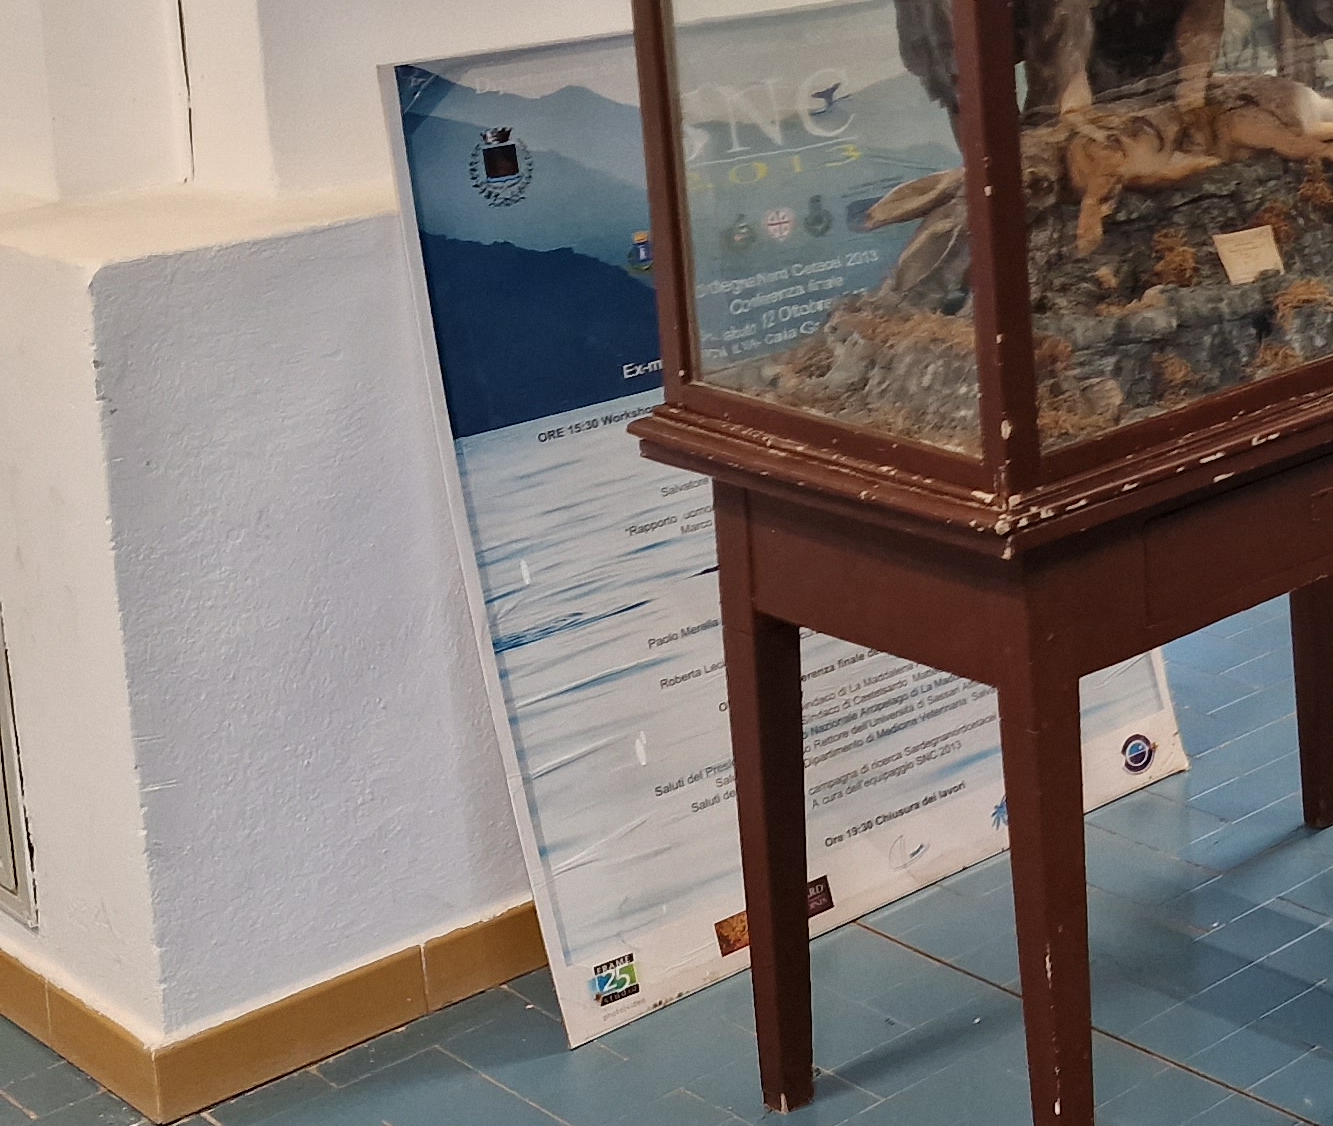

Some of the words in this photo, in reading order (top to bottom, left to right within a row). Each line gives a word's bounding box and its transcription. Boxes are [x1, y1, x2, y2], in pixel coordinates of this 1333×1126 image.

[845, 249, 879, 266] 2013
[730, 285, 805, 315] Conferenza
[622, 358, 664, 378] Ex-m
[537, 426, 565, 444] ORE
[567, 420, 599, 436] 15:30
[601, 406, 655, 426] Worksho
[660, 477, 709, 497] Salvatore
[648, 632, 679, 649] Paolo
[837, 653, 866, 669] finale
[660, 668, 702, 689] Roberta
[813, 730, 850, 749] Rettore
[654, 778, 686, 798] Saluti
[687, 770, 703, 785] del
[810, 712, 857, 736] Nazionale
[691, 794, 721, 813] Saluti
[804, 738, 864, 769] Dipartimento
[876, 717, 918, 739] Medicina
[808, 772, 859, 796] campagna
[870, 751, 903, 770] ricerca
[811, 797, 820, 810] A
[821, 791, 844, 805] cura
[915, 750, 938, 767] SNC
[938, 739, 963, 758] 2013
[846, 819, 874, 838] 19:30
[874, 801, 921, 826] Chiusura
[921, 791, 938, 807] dei
[938, 779, 967, 799] lavori
[595, 954, 633, 975] FRAME
[595, 967, 632, 994] 25
